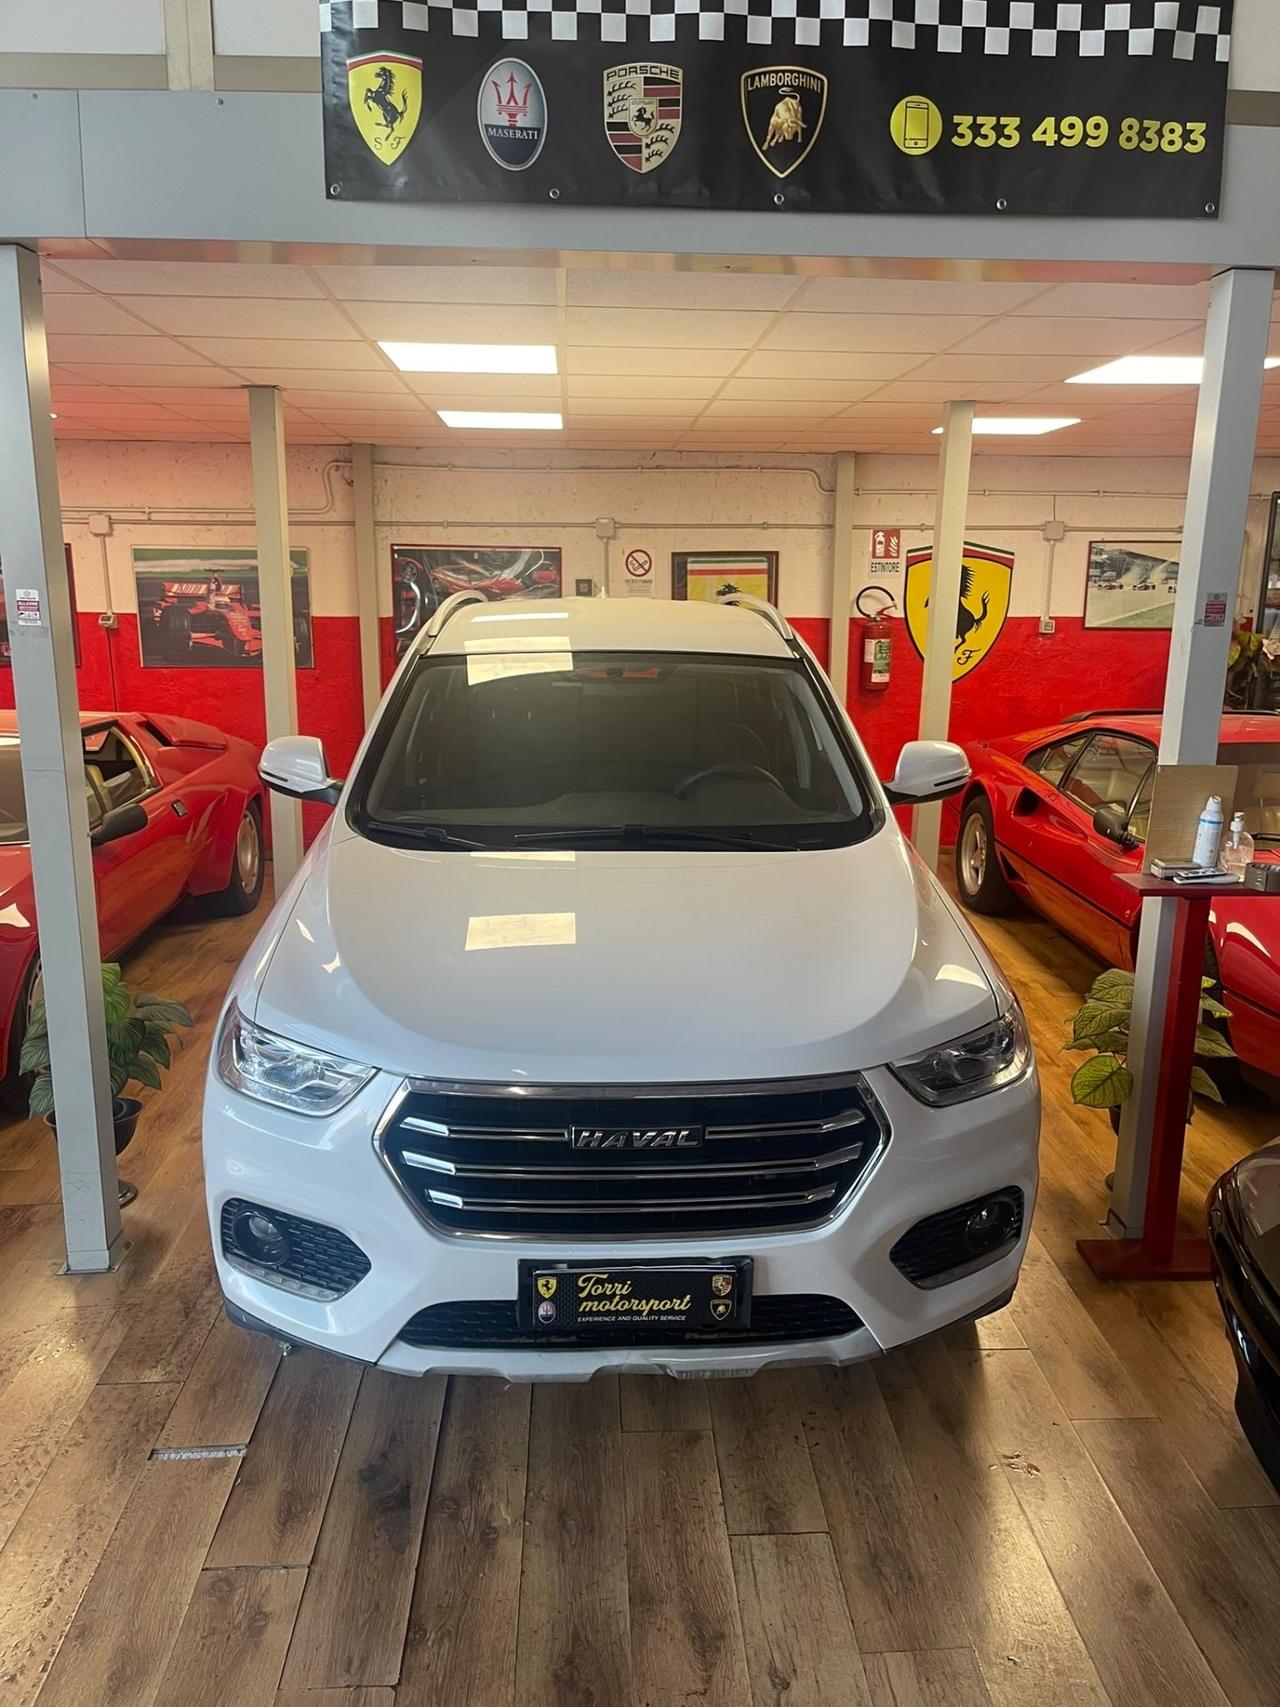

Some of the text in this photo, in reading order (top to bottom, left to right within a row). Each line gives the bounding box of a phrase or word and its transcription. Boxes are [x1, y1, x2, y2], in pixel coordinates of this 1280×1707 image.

[606, 65, 681, 81] PORSCHE
[747, 72, 821, 93] LAMBORGHINI
[487, 127, 538, 140] MASERATI
[951, 115, 1207, 153] 333 499 8383
[870, 561, 900, 573] ESTINTORE
[576, 1130, 699, 1148] HAVAL
[577, 1273, 632, 1298] Torri
[578, 1294, 692, 1317] motorsport
[578, 1315, 616, 1323] EXPERIENCE
[632, 1314, 659, 1322] QUALITY
